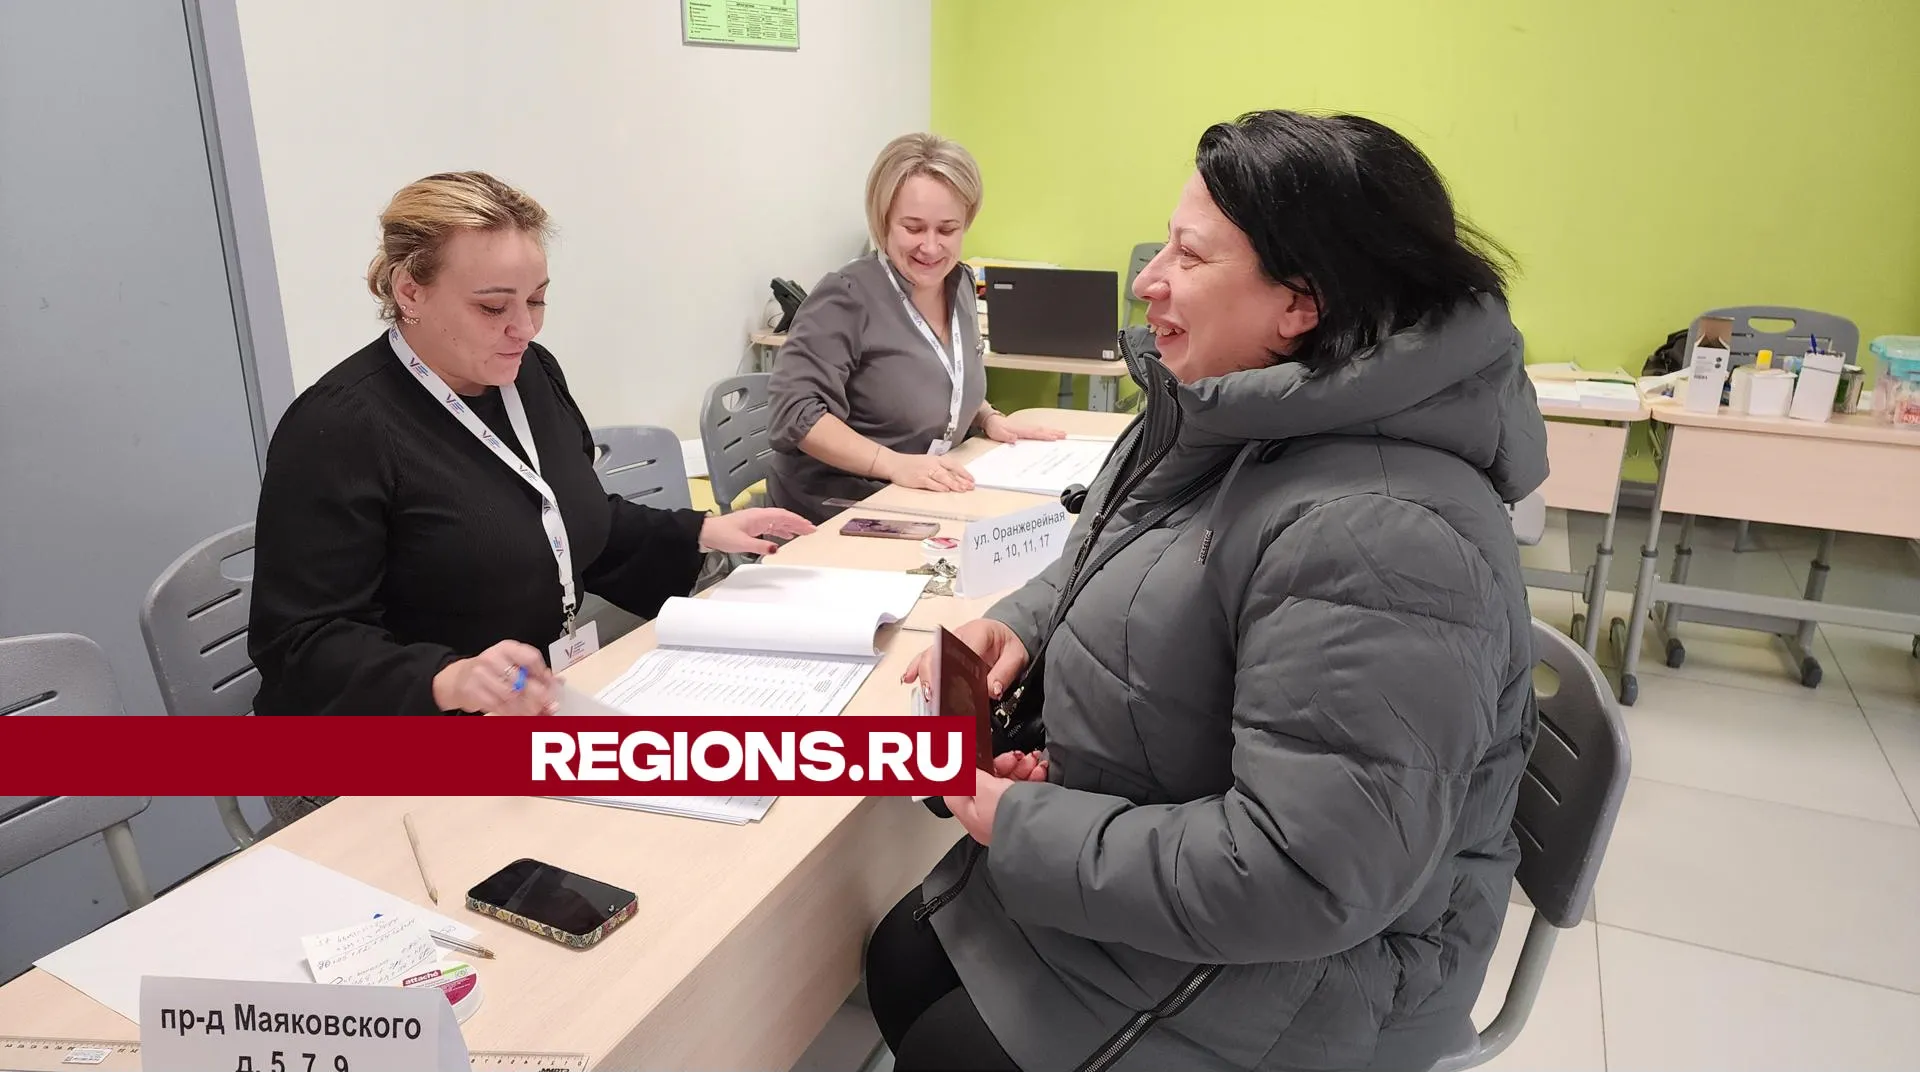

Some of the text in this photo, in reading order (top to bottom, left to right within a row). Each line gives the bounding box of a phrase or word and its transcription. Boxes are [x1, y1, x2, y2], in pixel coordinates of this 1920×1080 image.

[973, 511, 1066, 550] ул. Оранжерейная
[993, 533, 1050, 564] д. 10, 11, 17
[161, 1003, 422, 1039] пр-д Маяковского
